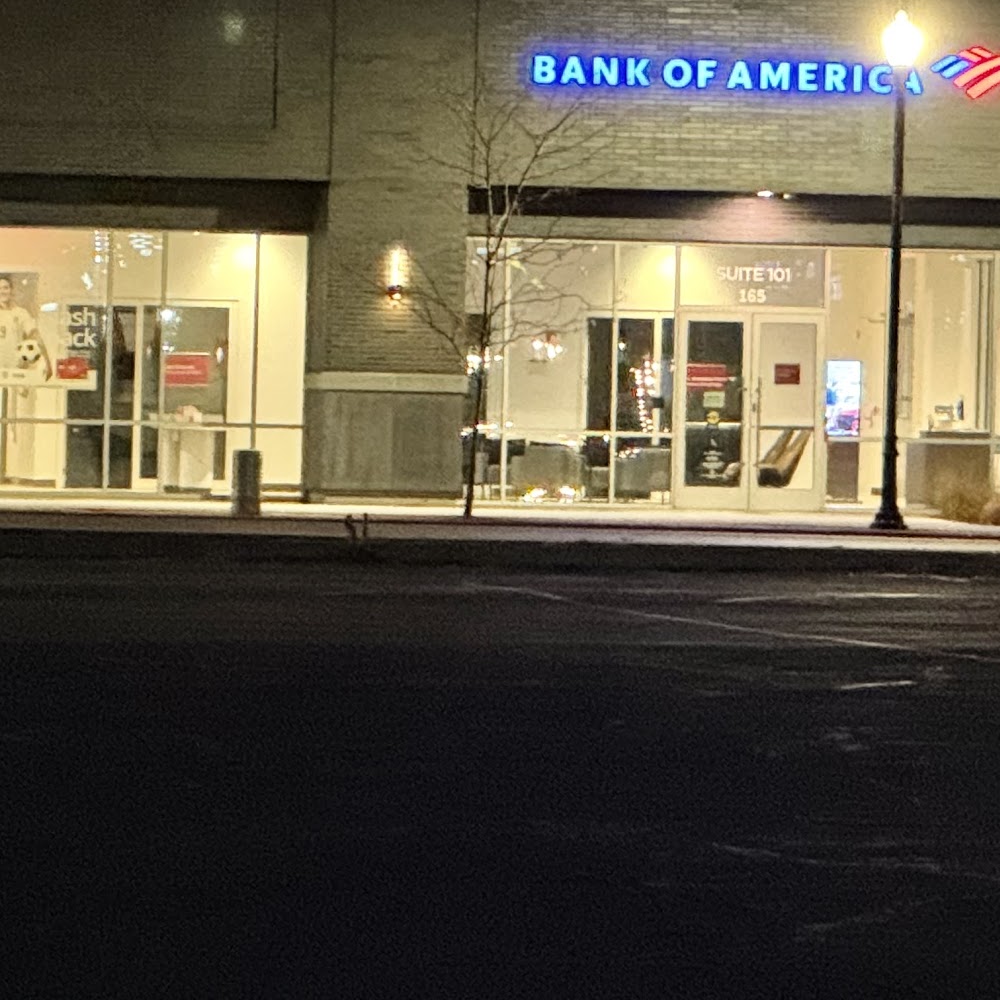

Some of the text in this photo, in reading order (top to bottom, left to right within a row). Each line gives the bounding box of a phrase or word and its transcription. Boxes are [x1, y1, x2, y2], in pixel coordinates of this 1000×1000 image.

[532, 54, 651, 87] BANK
[662, 58, 718, 89] OF
[716, 265, 791, 282] SUITE 101
[738, 287, 767, 303] 165
